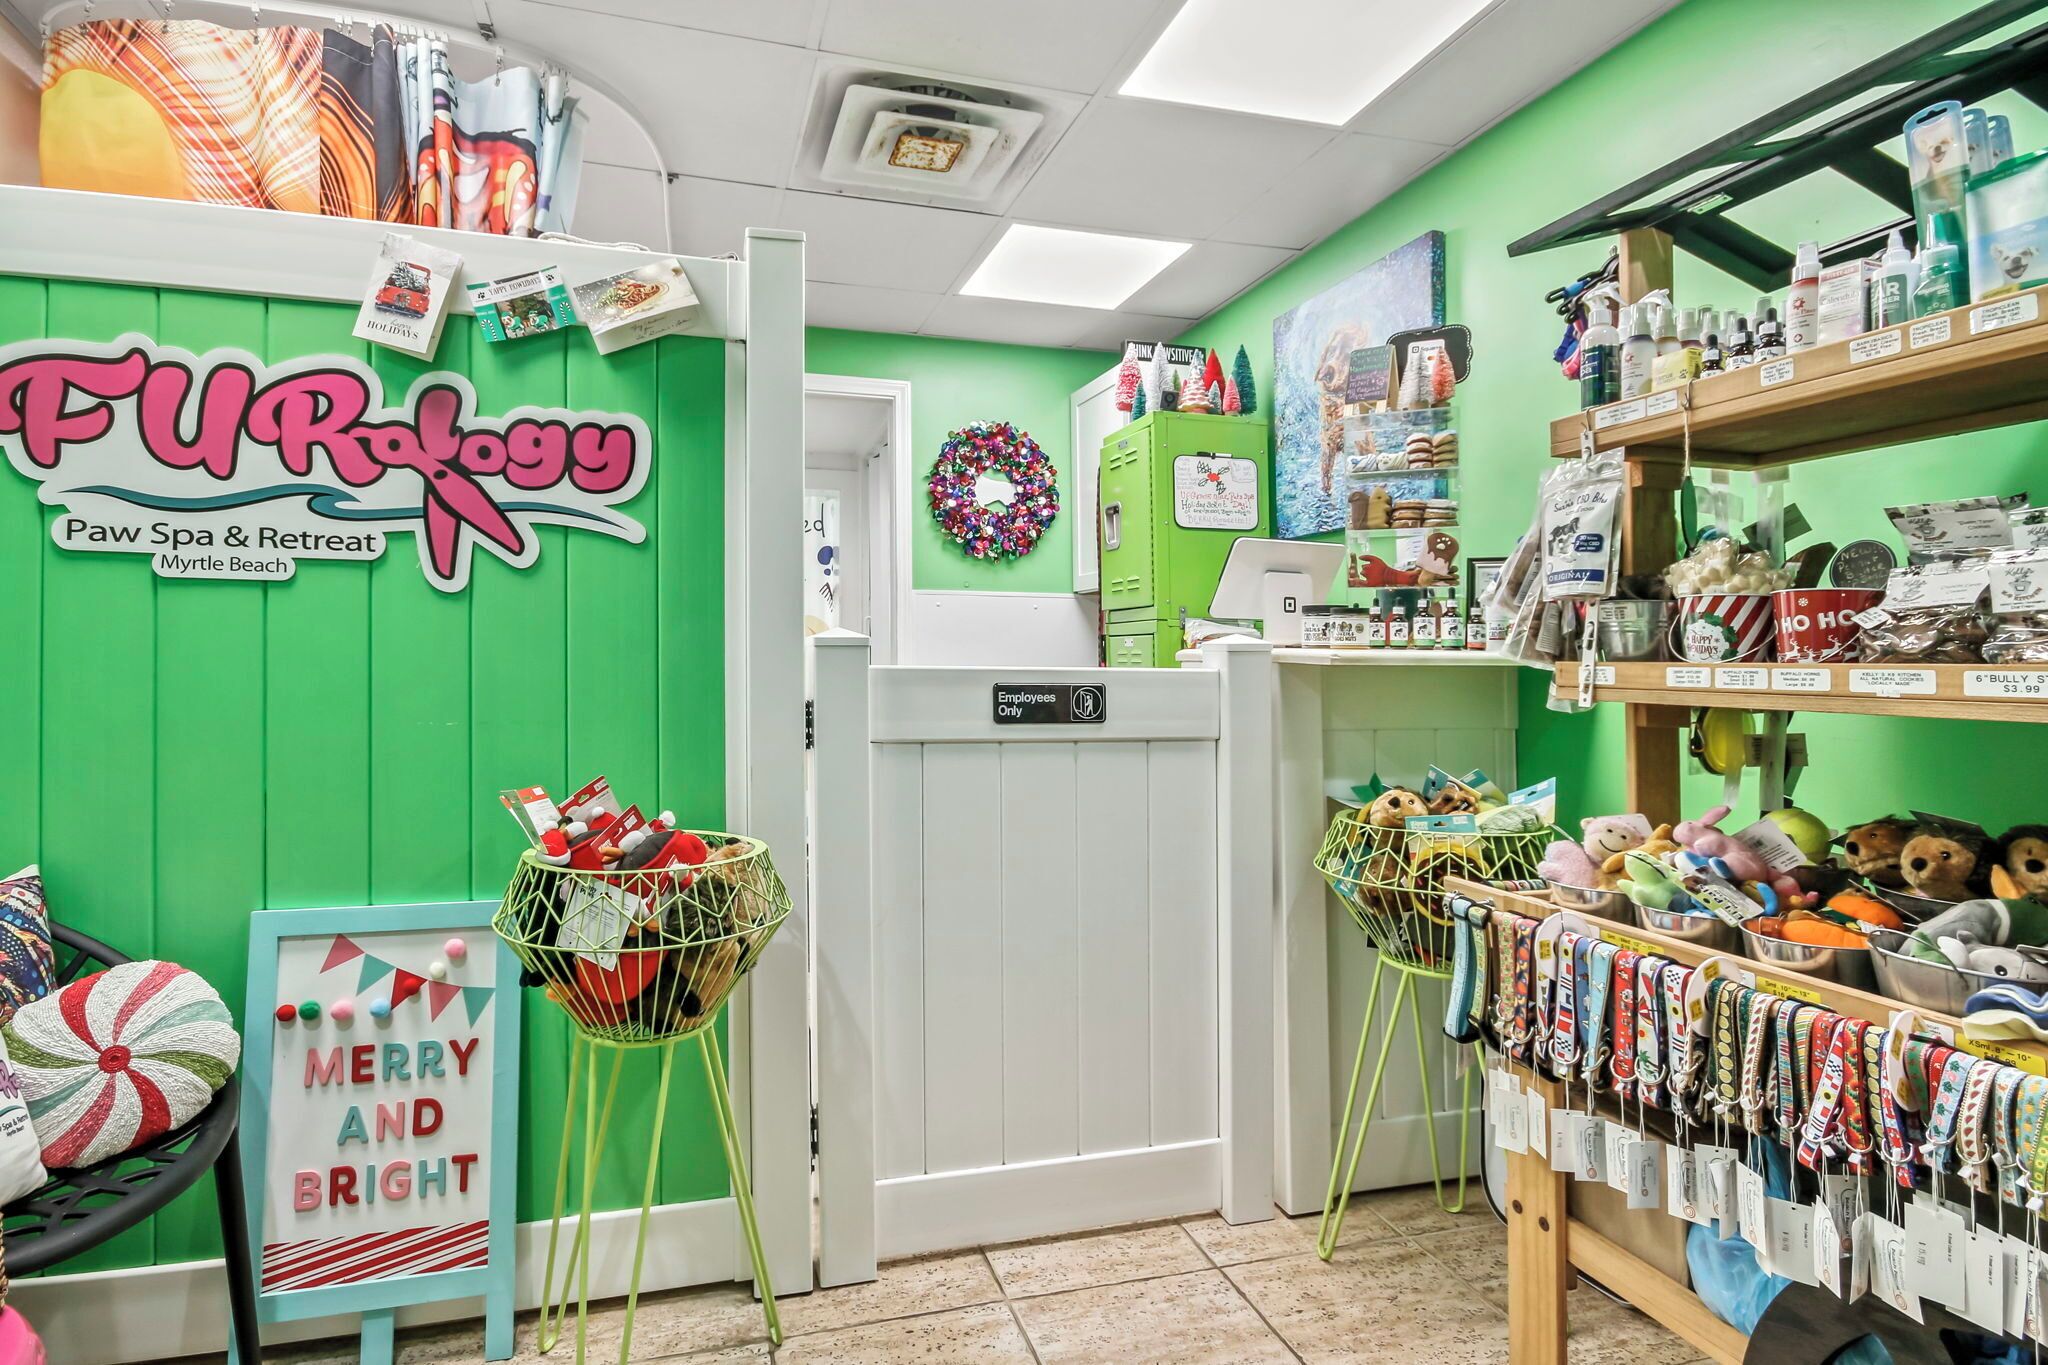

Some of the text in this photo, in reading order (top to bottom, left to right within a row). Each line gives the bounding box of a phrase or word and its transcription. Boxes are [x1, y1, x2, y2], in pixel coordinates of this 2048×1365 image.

[367, 320, 420, 340] HOLIDAYS
[1131, 343, 1153, 359] HINK
[66, 518, 377, 553] Paw Spa & Retreat
[160, 554, 288, 574] Myrtle Beach
[1548, 571, 1589, 583] ORIGINAL
[1690, 635, 1713, 645] HAPPY
[998, 692, 1057, 705] Employees
[998, 705, 1023, 718] Only
[304, 1037, 479, 1088] MERRY
[336, 1097, 444, 1147] AND
[293, 1153, 479, 1212] BRIGHT
